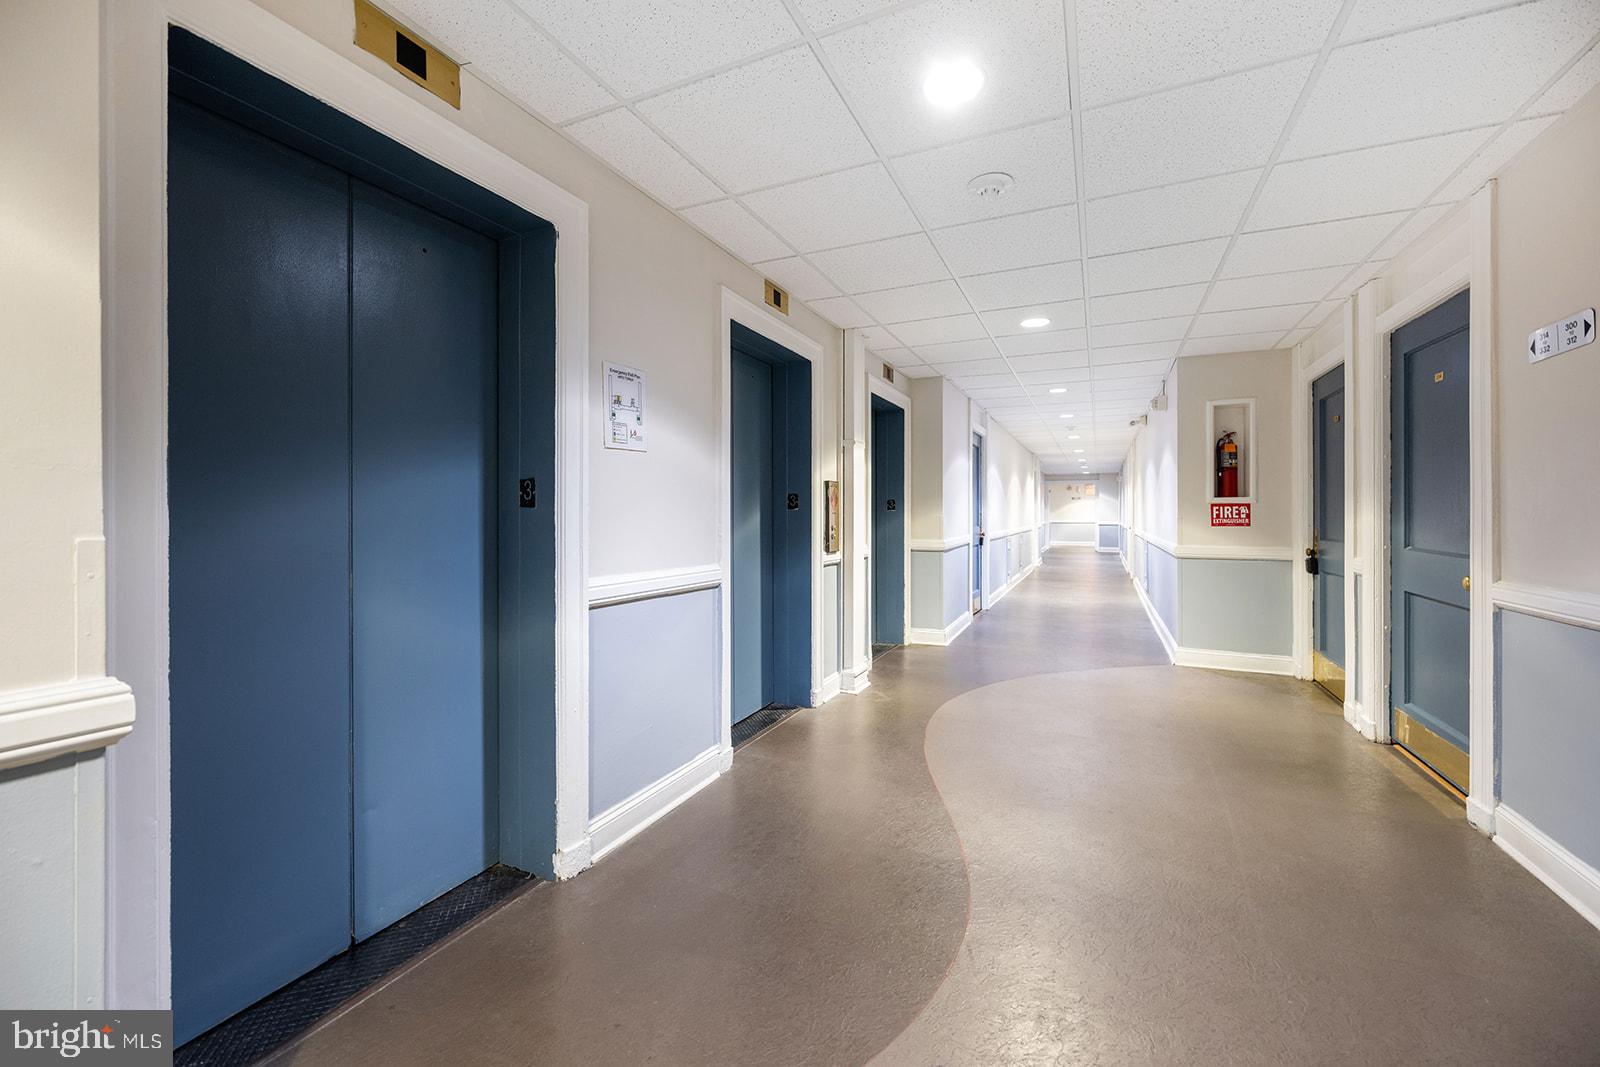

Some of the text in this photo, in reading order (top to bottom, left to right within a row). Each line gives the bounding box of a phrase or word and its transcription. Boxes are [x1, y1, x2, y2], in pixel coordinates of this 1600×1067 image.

[1565, 320, 1577, 331] 300
[1567, 335, 1577, 345] 312
[524, 480, 531, 500] 3
[790, 494, 796, 506] 3
[1213, 506, 1239, 518] FIRE
